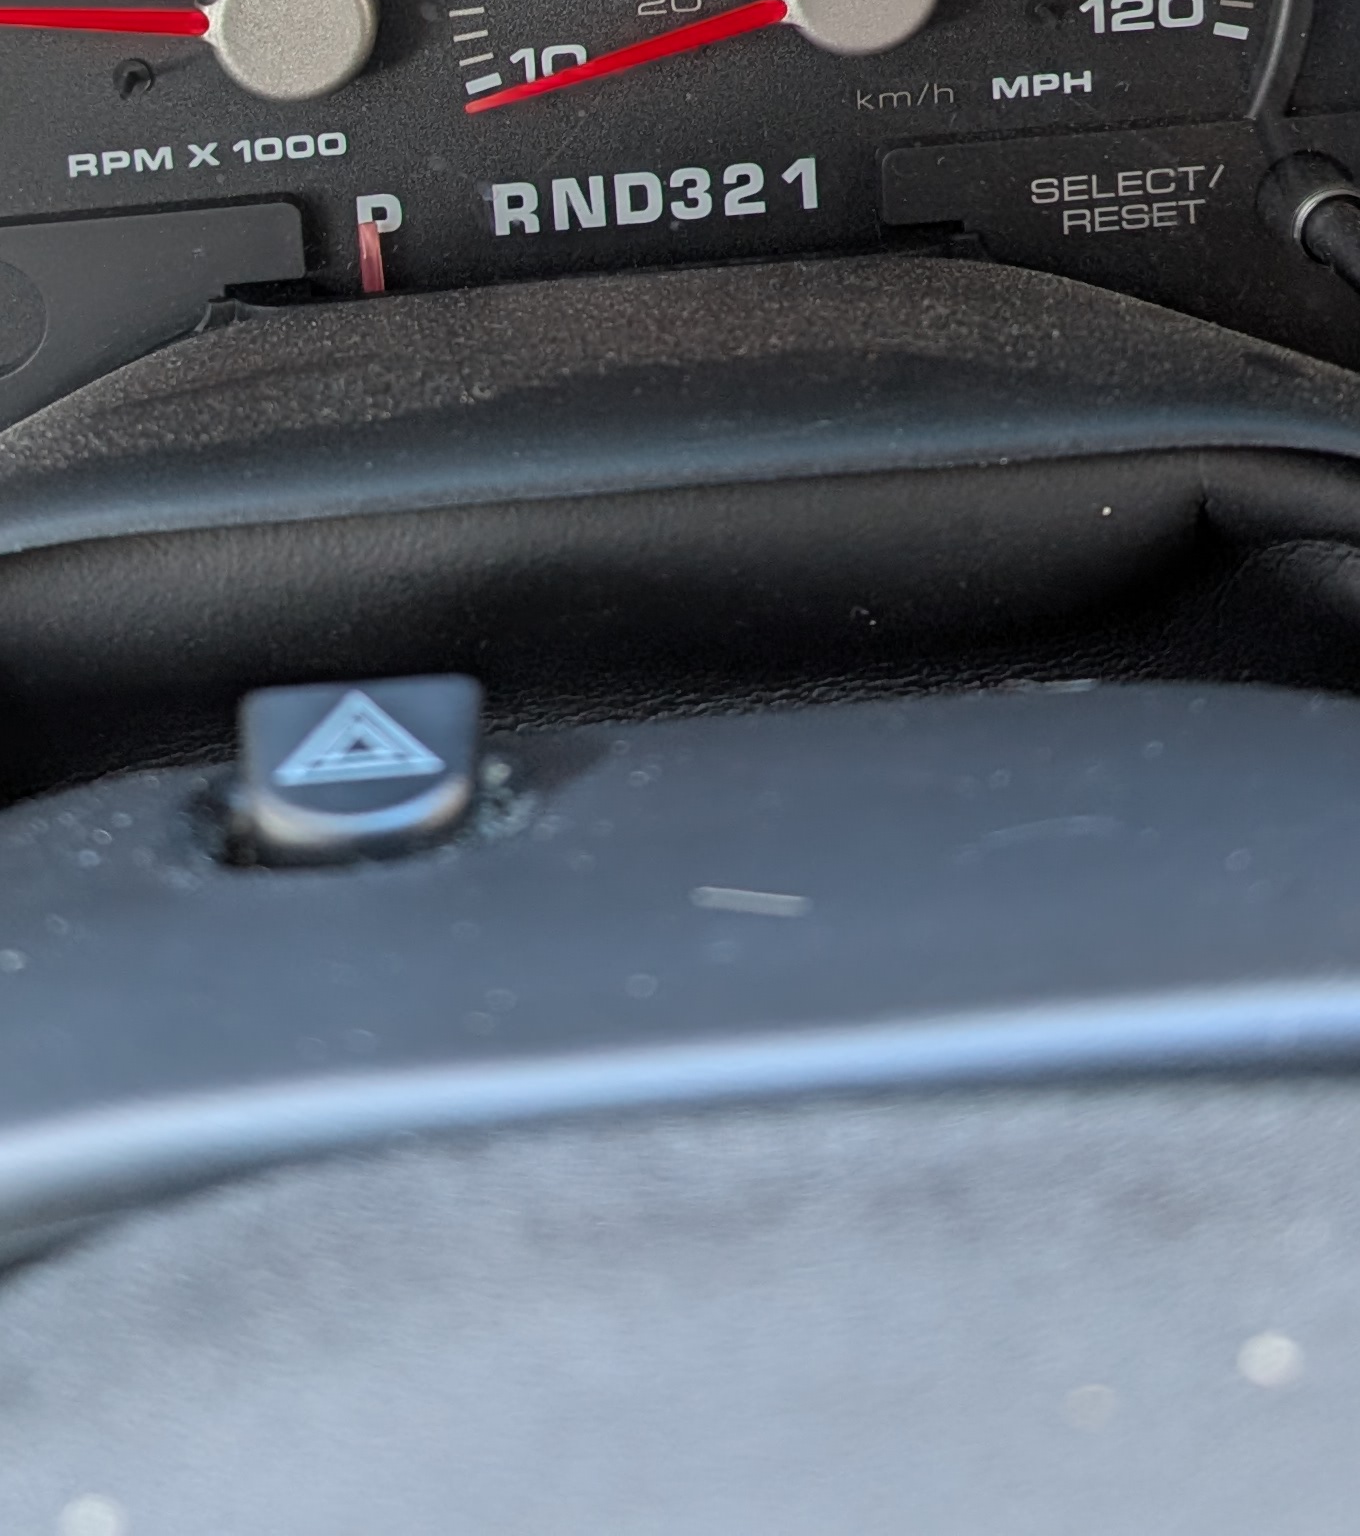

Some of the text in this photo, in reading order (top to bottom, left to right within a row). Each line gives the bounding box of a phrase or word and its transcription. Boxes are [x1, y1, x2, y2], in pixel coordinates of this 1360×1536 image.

[856, 81, 954, 110] km/h
[991, 70, 1092, 100] MPH
[67, 131, 347, 178] RPM X 1000
[1030, 163, 1225, 205] SELECT/
[355, 192, 403, 234] P
[1062, 198, 1206, 235] RESET
